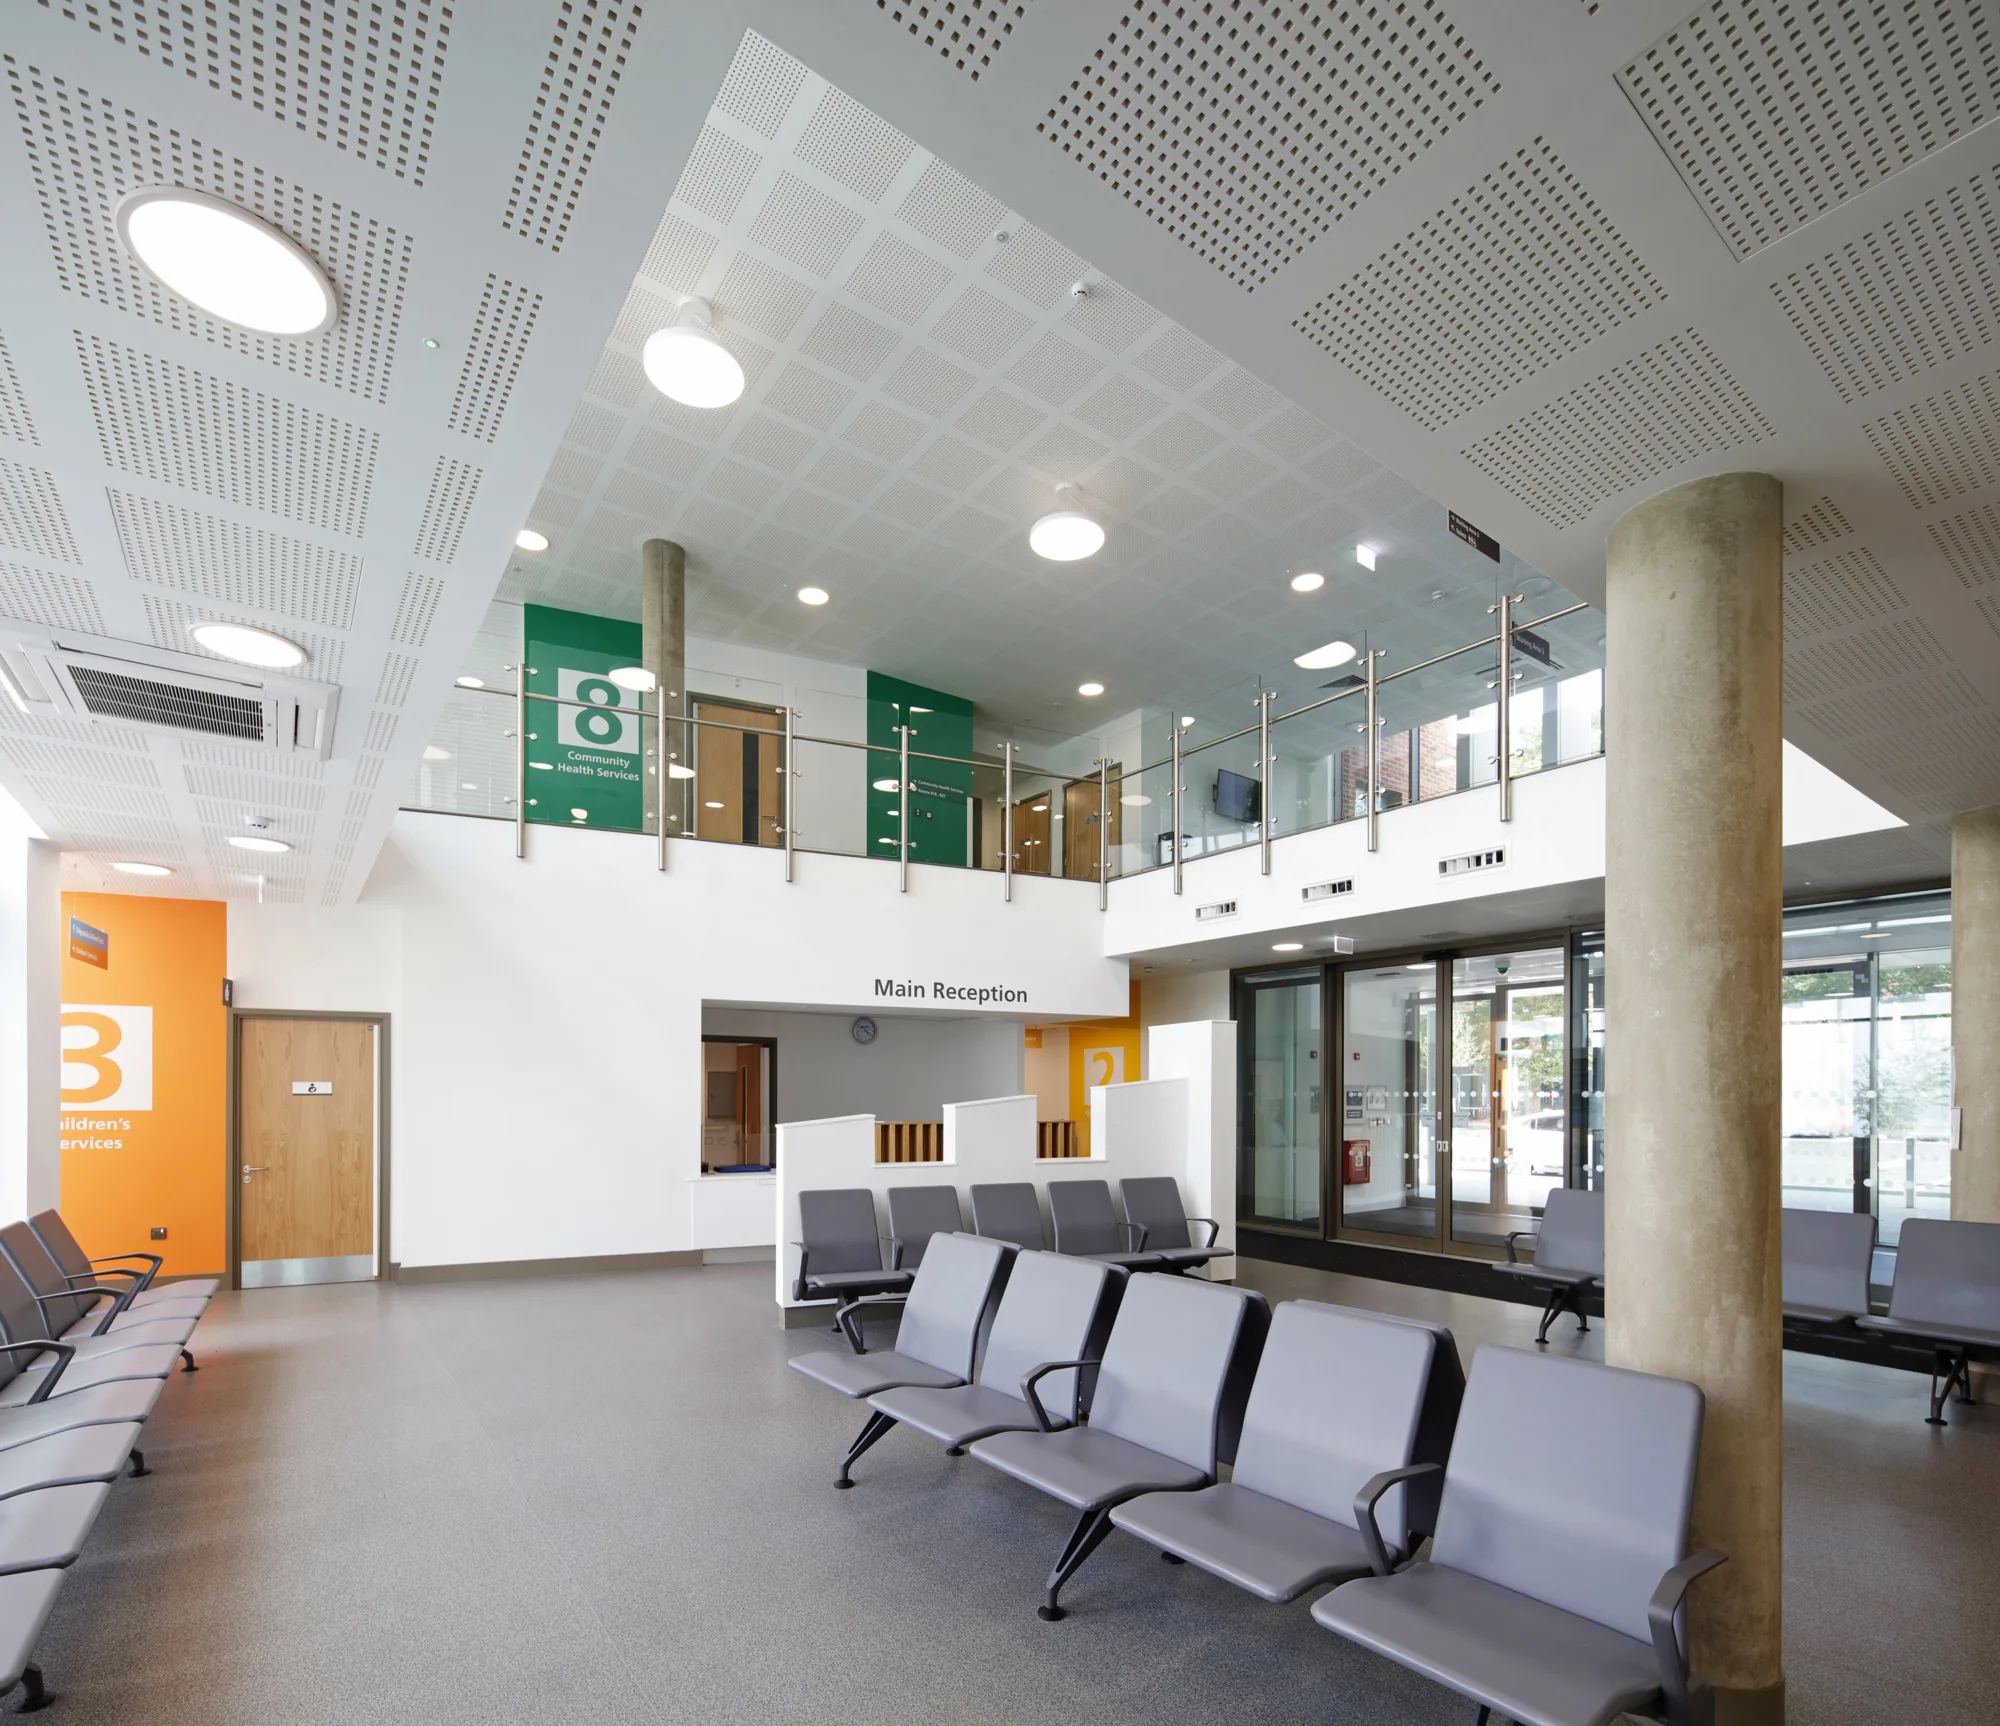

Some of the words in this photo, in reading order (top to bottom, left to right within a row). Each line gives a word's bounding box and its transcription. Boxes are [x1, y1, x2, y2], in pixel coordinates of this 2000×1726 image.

[1455, 516, 1469, 532] Waiting
[575, 678, 623, 745] 8
[568, 751, 630, 768] Community
[557, 762, 594, 776] Health
[597, 767, 640, 782] Services
[918, 780, 938, 788] Community
[874, 978, 926, 998] Main
[933, 982, 1028, 1006] Reception
[60, 1011, 123, 1104] 3
[1093, 1051, 1115, 1087] 2
[60, 1117, 131, 1131] ildren's
[60, 1136, 123, 1150] ervices
